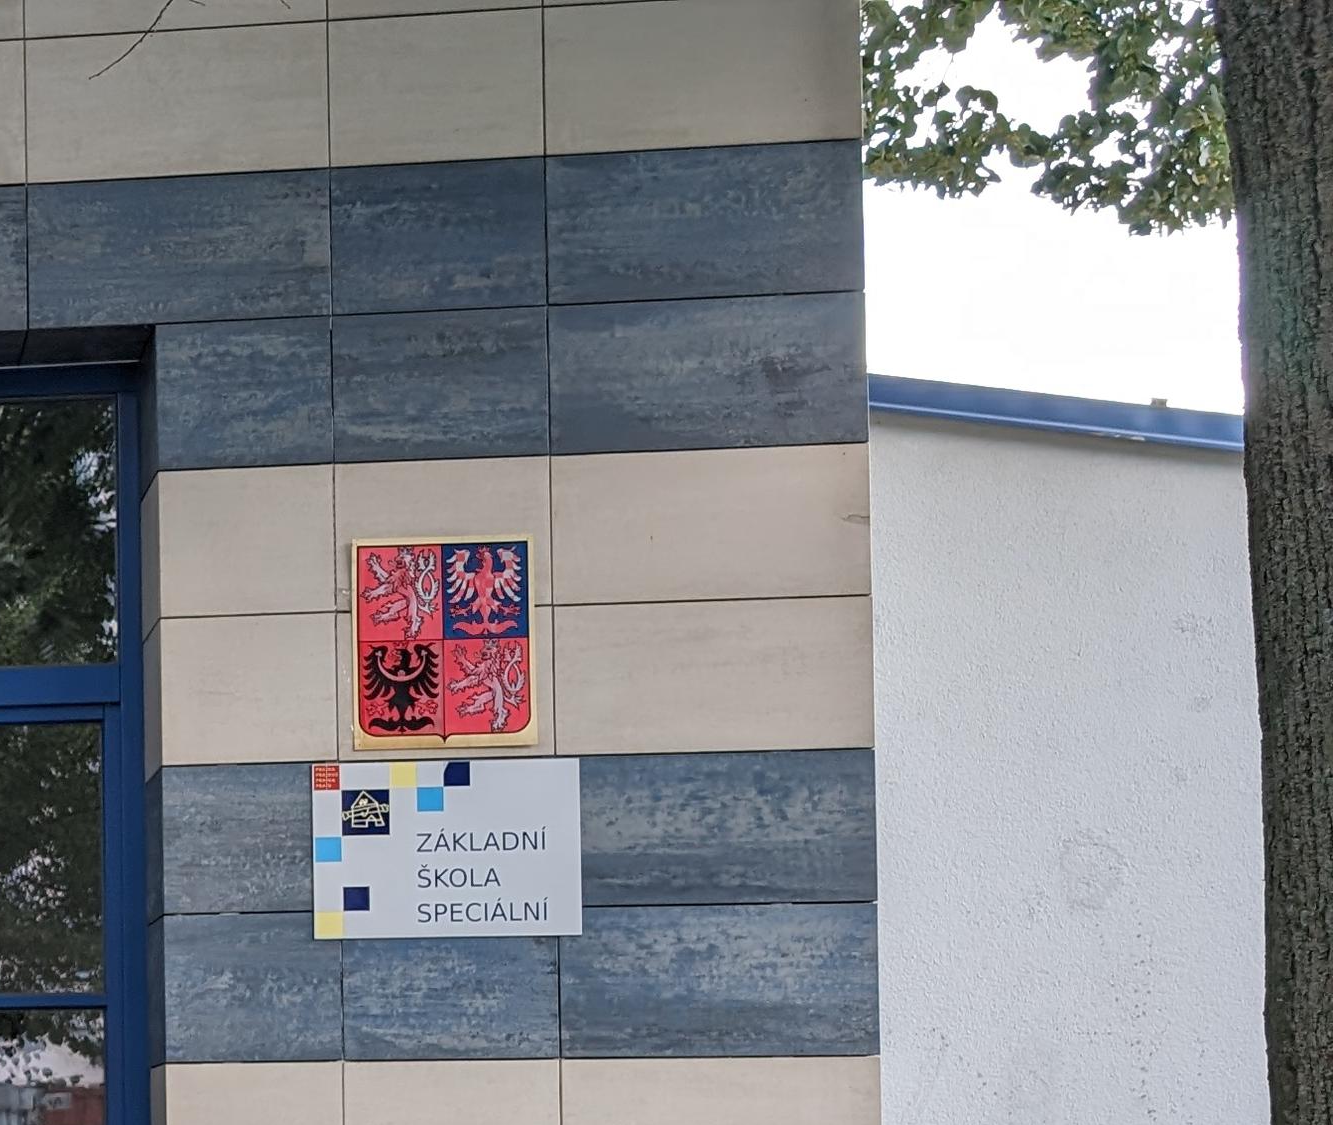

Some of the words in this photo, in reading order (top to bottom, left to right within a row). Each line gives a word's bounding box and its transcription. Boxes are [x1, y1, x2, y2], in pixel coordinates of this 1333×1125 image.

[416, 826, 546, 853] ZÁKLADNÍ
[417, 864, 501, 888] ŠKOLA
[417, 896, 548, 923] SPECIÁLNÍ
